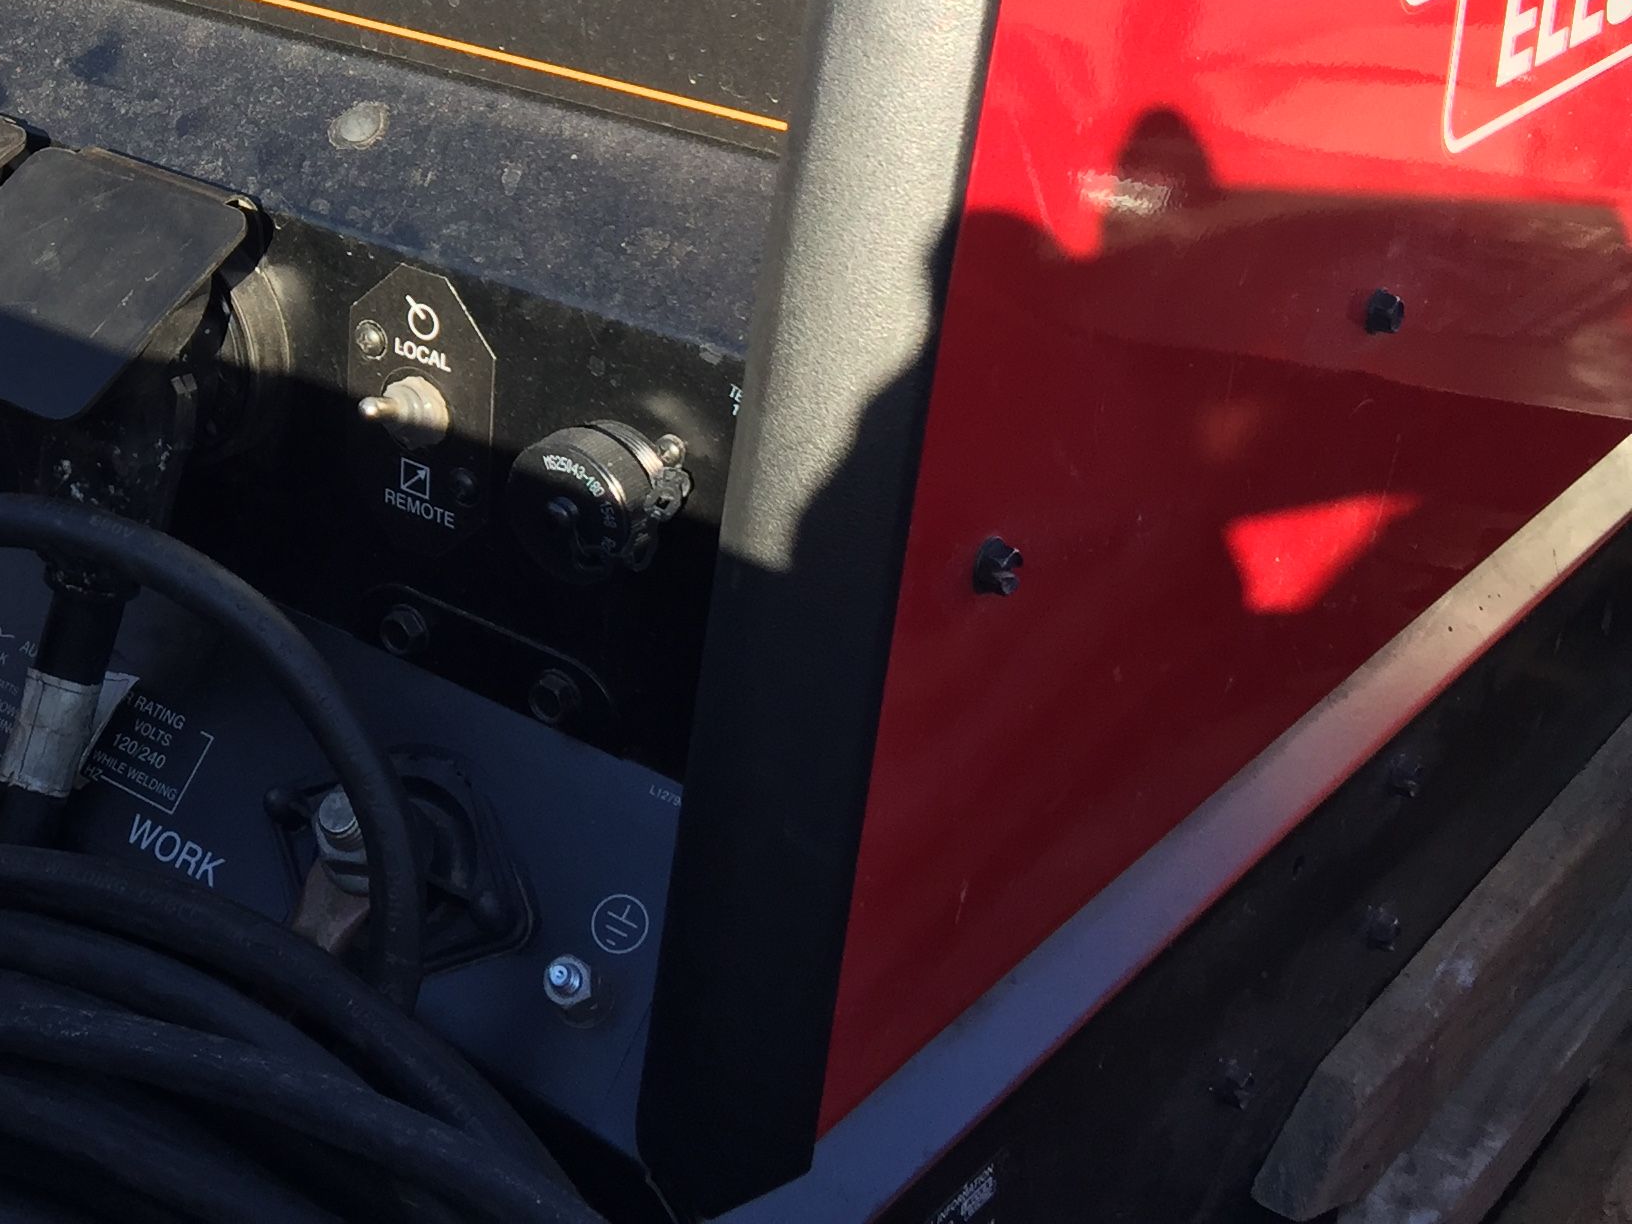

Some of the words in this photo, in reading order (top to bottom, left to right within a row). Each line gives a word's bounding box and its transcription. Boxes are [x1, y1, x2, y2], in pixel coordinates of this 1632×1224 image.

[394, 337, 451, 372] LOCAL
[384, 488, 455, 529] REMOTE
[133, 694, 187, 732] RATING
[133, 717, 174, 747] VOLTS
[111, 732, 168, 771] 120/240
[91, 748, 130, 776] WHILE
[126, 765, 179, 803] WELDING
[127, 813, 227, 890] WORK
